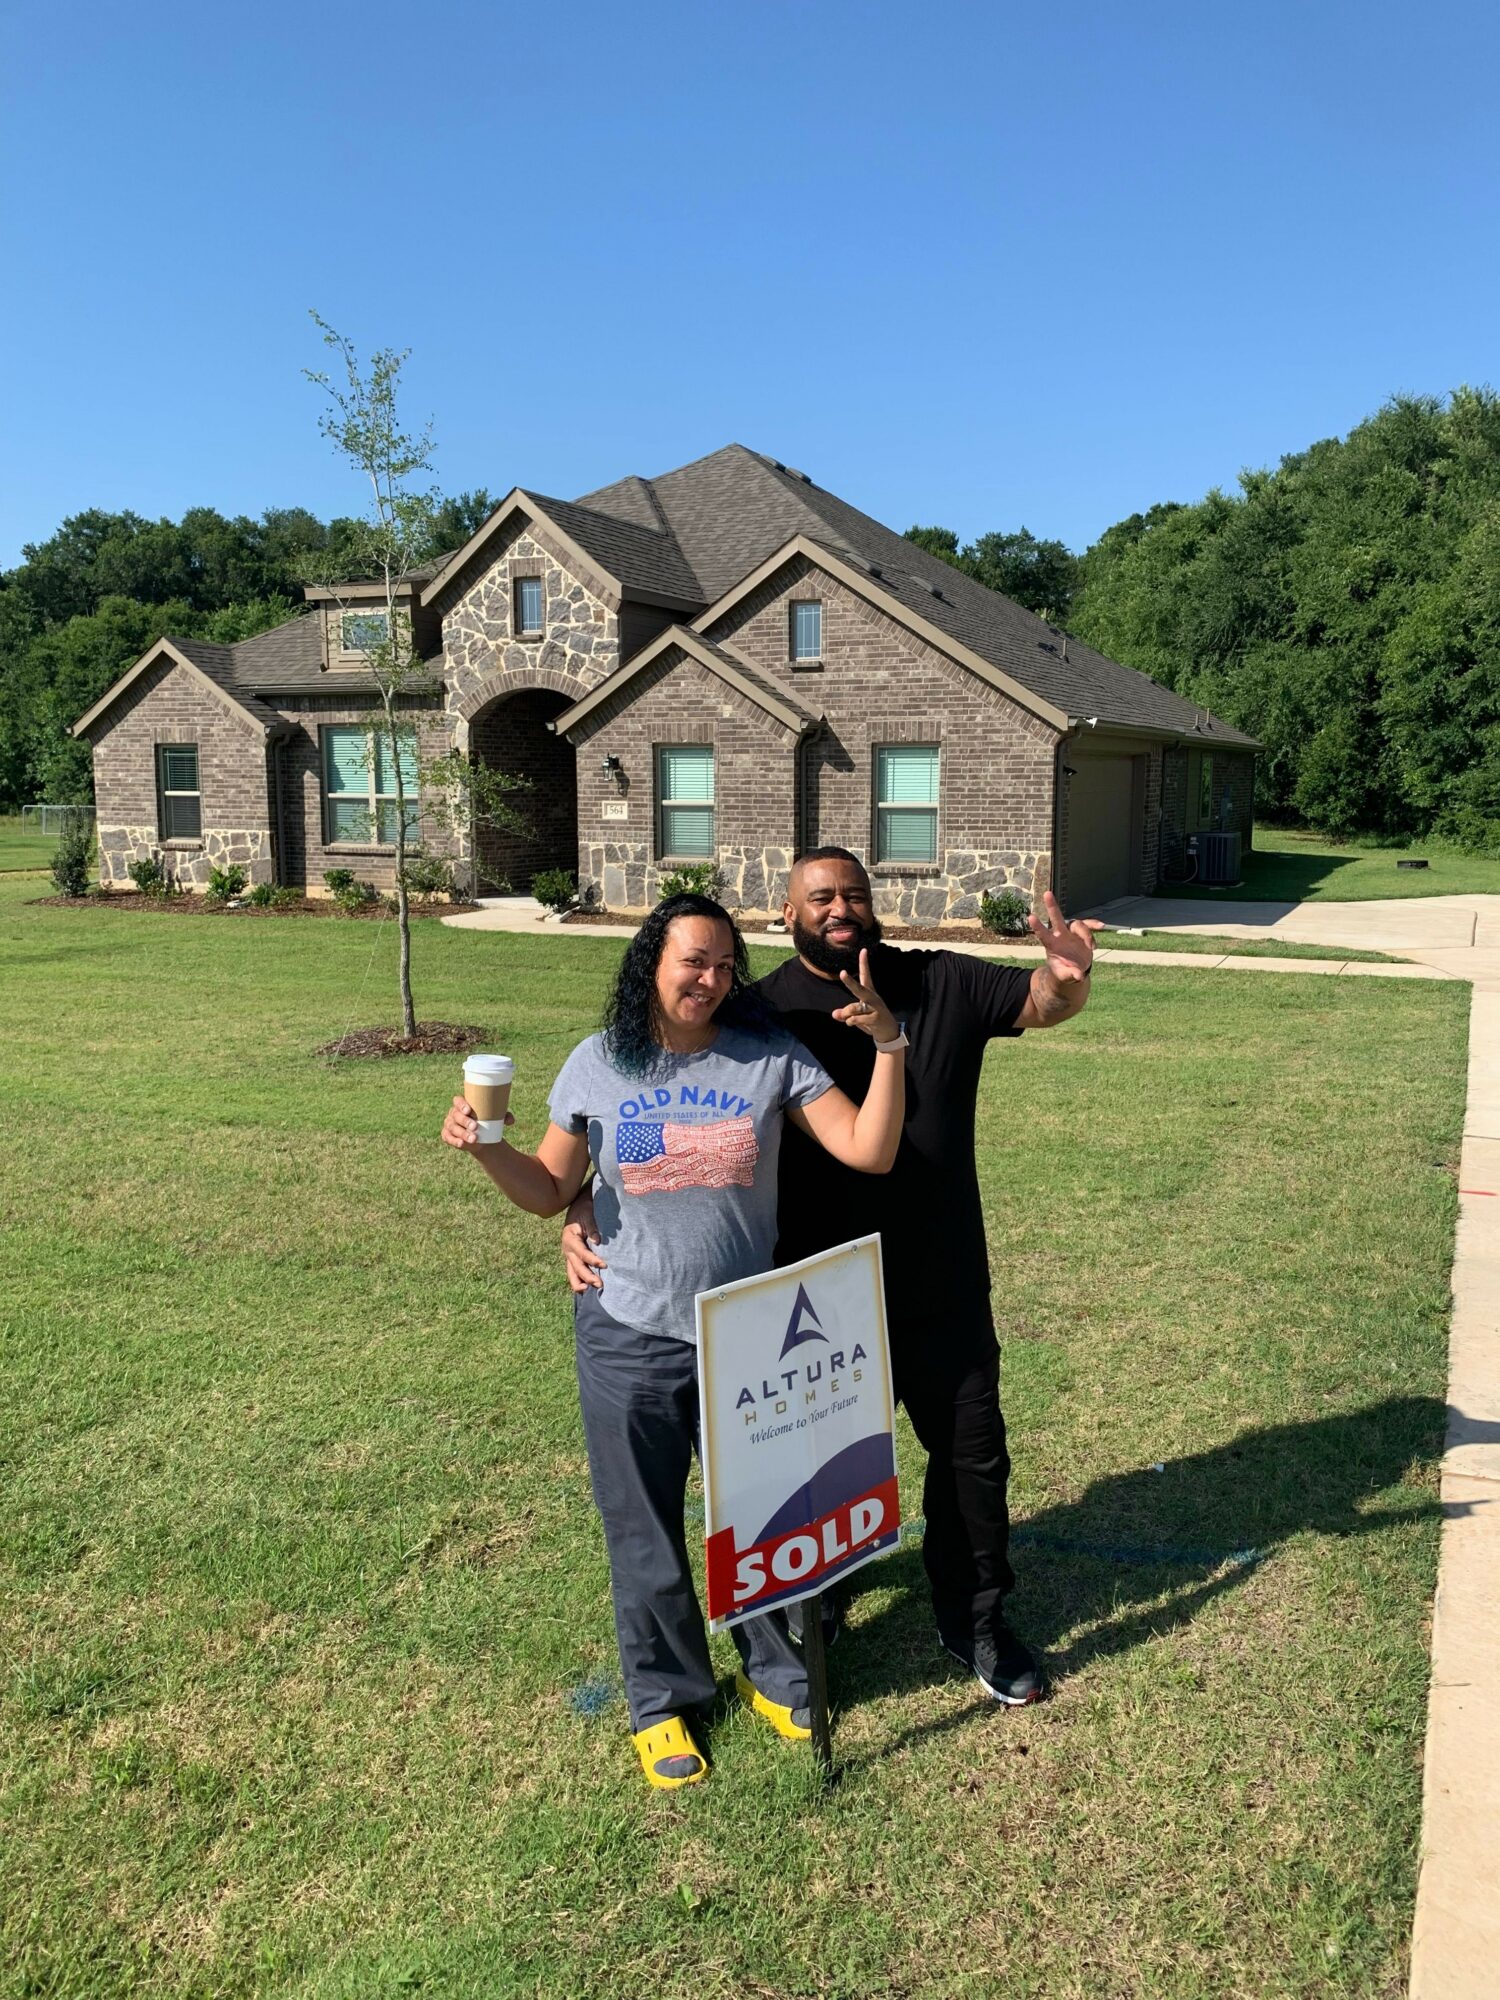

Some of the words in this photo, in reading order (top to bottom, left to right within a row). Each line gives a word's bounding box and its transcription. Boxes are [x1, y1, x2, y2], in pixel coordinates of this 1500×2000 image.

[619, 1088, 671, 1119] OLD
[680, 1086, 753, 1117] NAVY
[673, 1111, 697, 1119] STATES
[736, 1343, 867, 1409] ALTURA
[745, 1369, 862, 1426] HOMES
[750, 1421, 794, 1444] Welcome
[796, 1418, 807, 1429] to
[808, 1407, 829, 1423] Your
[831, 1394, 858, 1413] Future
[733, 1498, 884, 1602] SOLD
